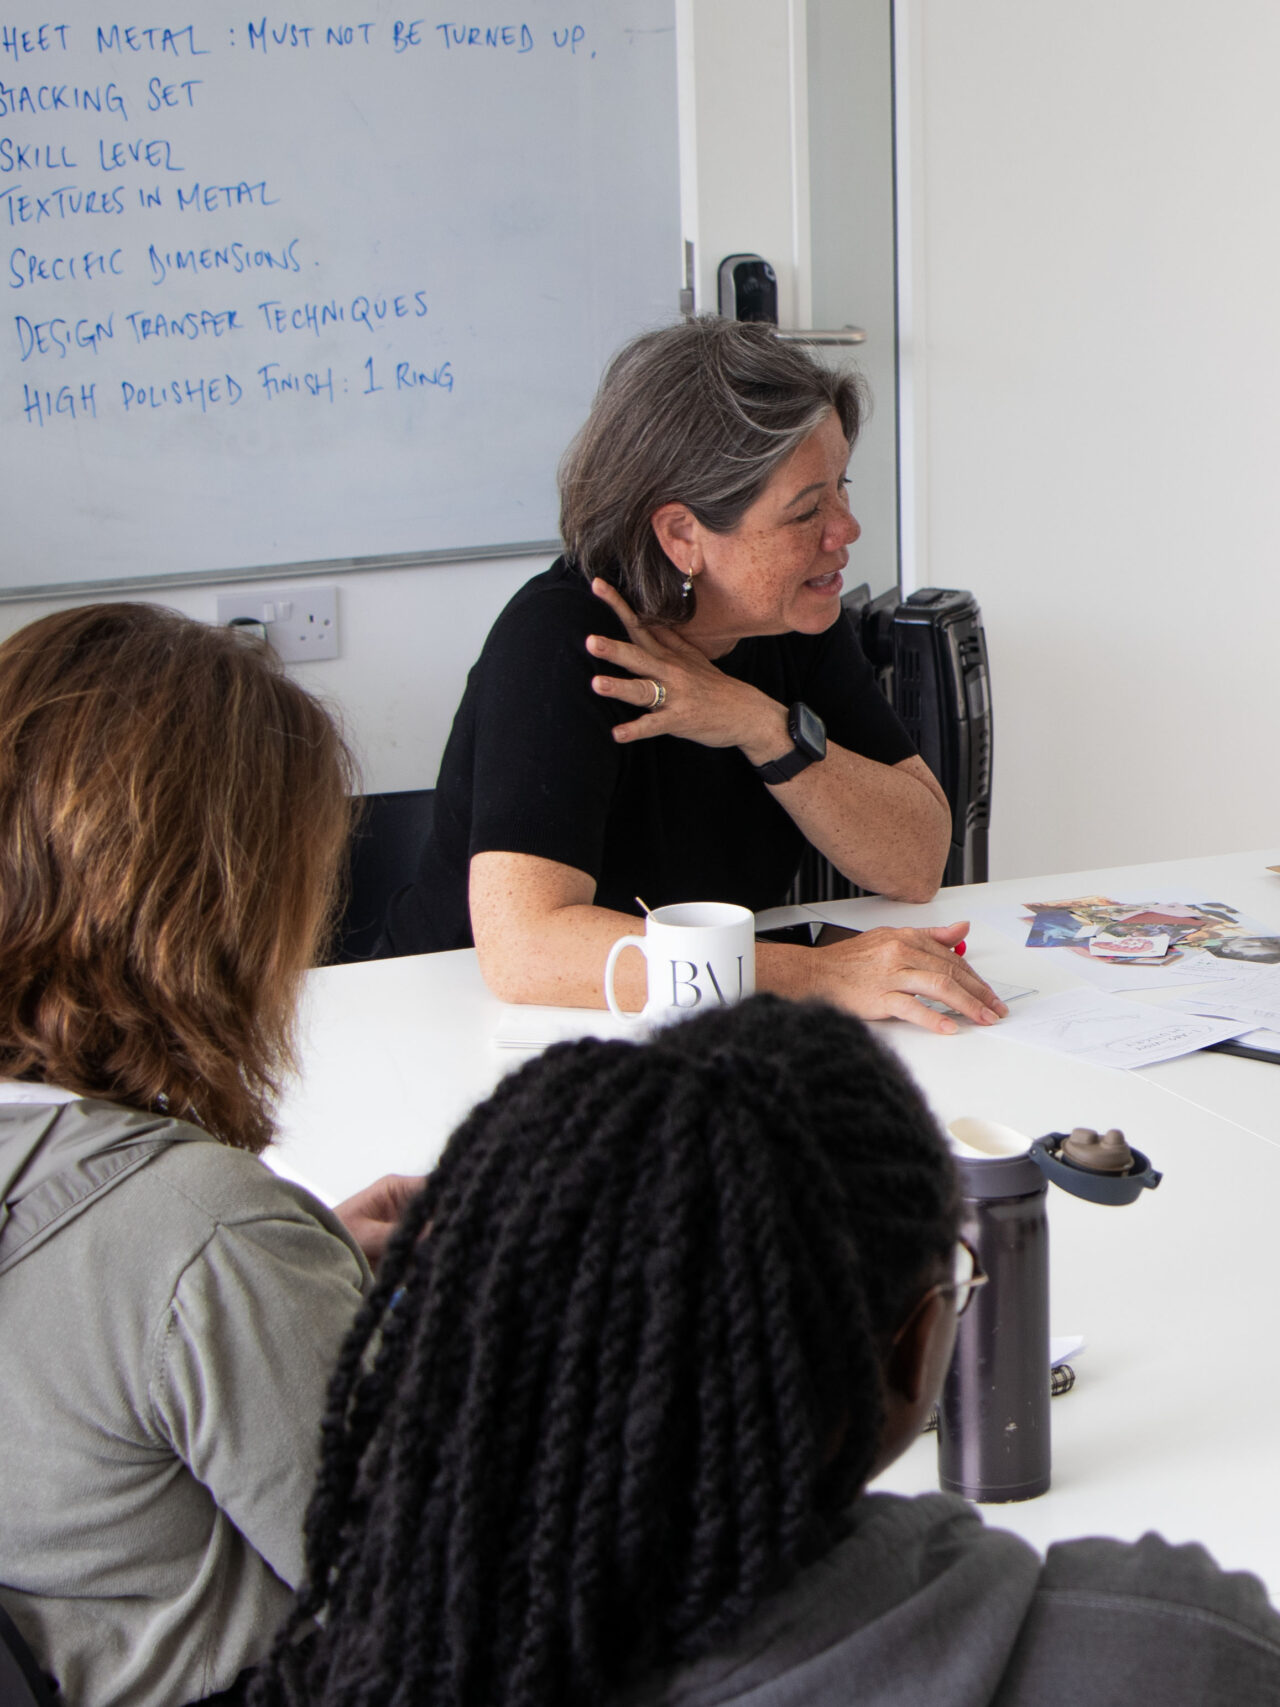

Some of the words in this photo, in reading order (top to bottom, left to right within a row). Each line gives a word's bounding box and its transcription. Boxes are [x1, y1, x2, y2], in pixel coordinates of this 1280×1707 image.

[1, 23, 70, 62] HEET
[96, 23, 209, 57] METAL
[247, 15, 313, 53] MUST
[325, 22, 374, 47] NOT
[391, 19, 425, 54] BE
[435, 22, 534, 54] TURNED
[147, 76, 202, 112] SET
[0, 136, 77, 173] SKILL
[98, 138, 185, 172] LEVEL
[0, 184, 125, 225] TEXTURES
[138, 186, 162, 209] IN
[176, 180, 281, 212] METAL
[9, 247, 122, 289] SPECIFIC
[14, 314, 114, 363] DESIGN
[125, 309, 241, 342] TRANSFER
[257, 290, 428, 337] TECHNIQUES
[23, 383, 97, 427] HIGH
[120, 373, 243, 412] POLISHED
[362, 355, 383, 395] 1
[395, 360, 454, 393] RING
